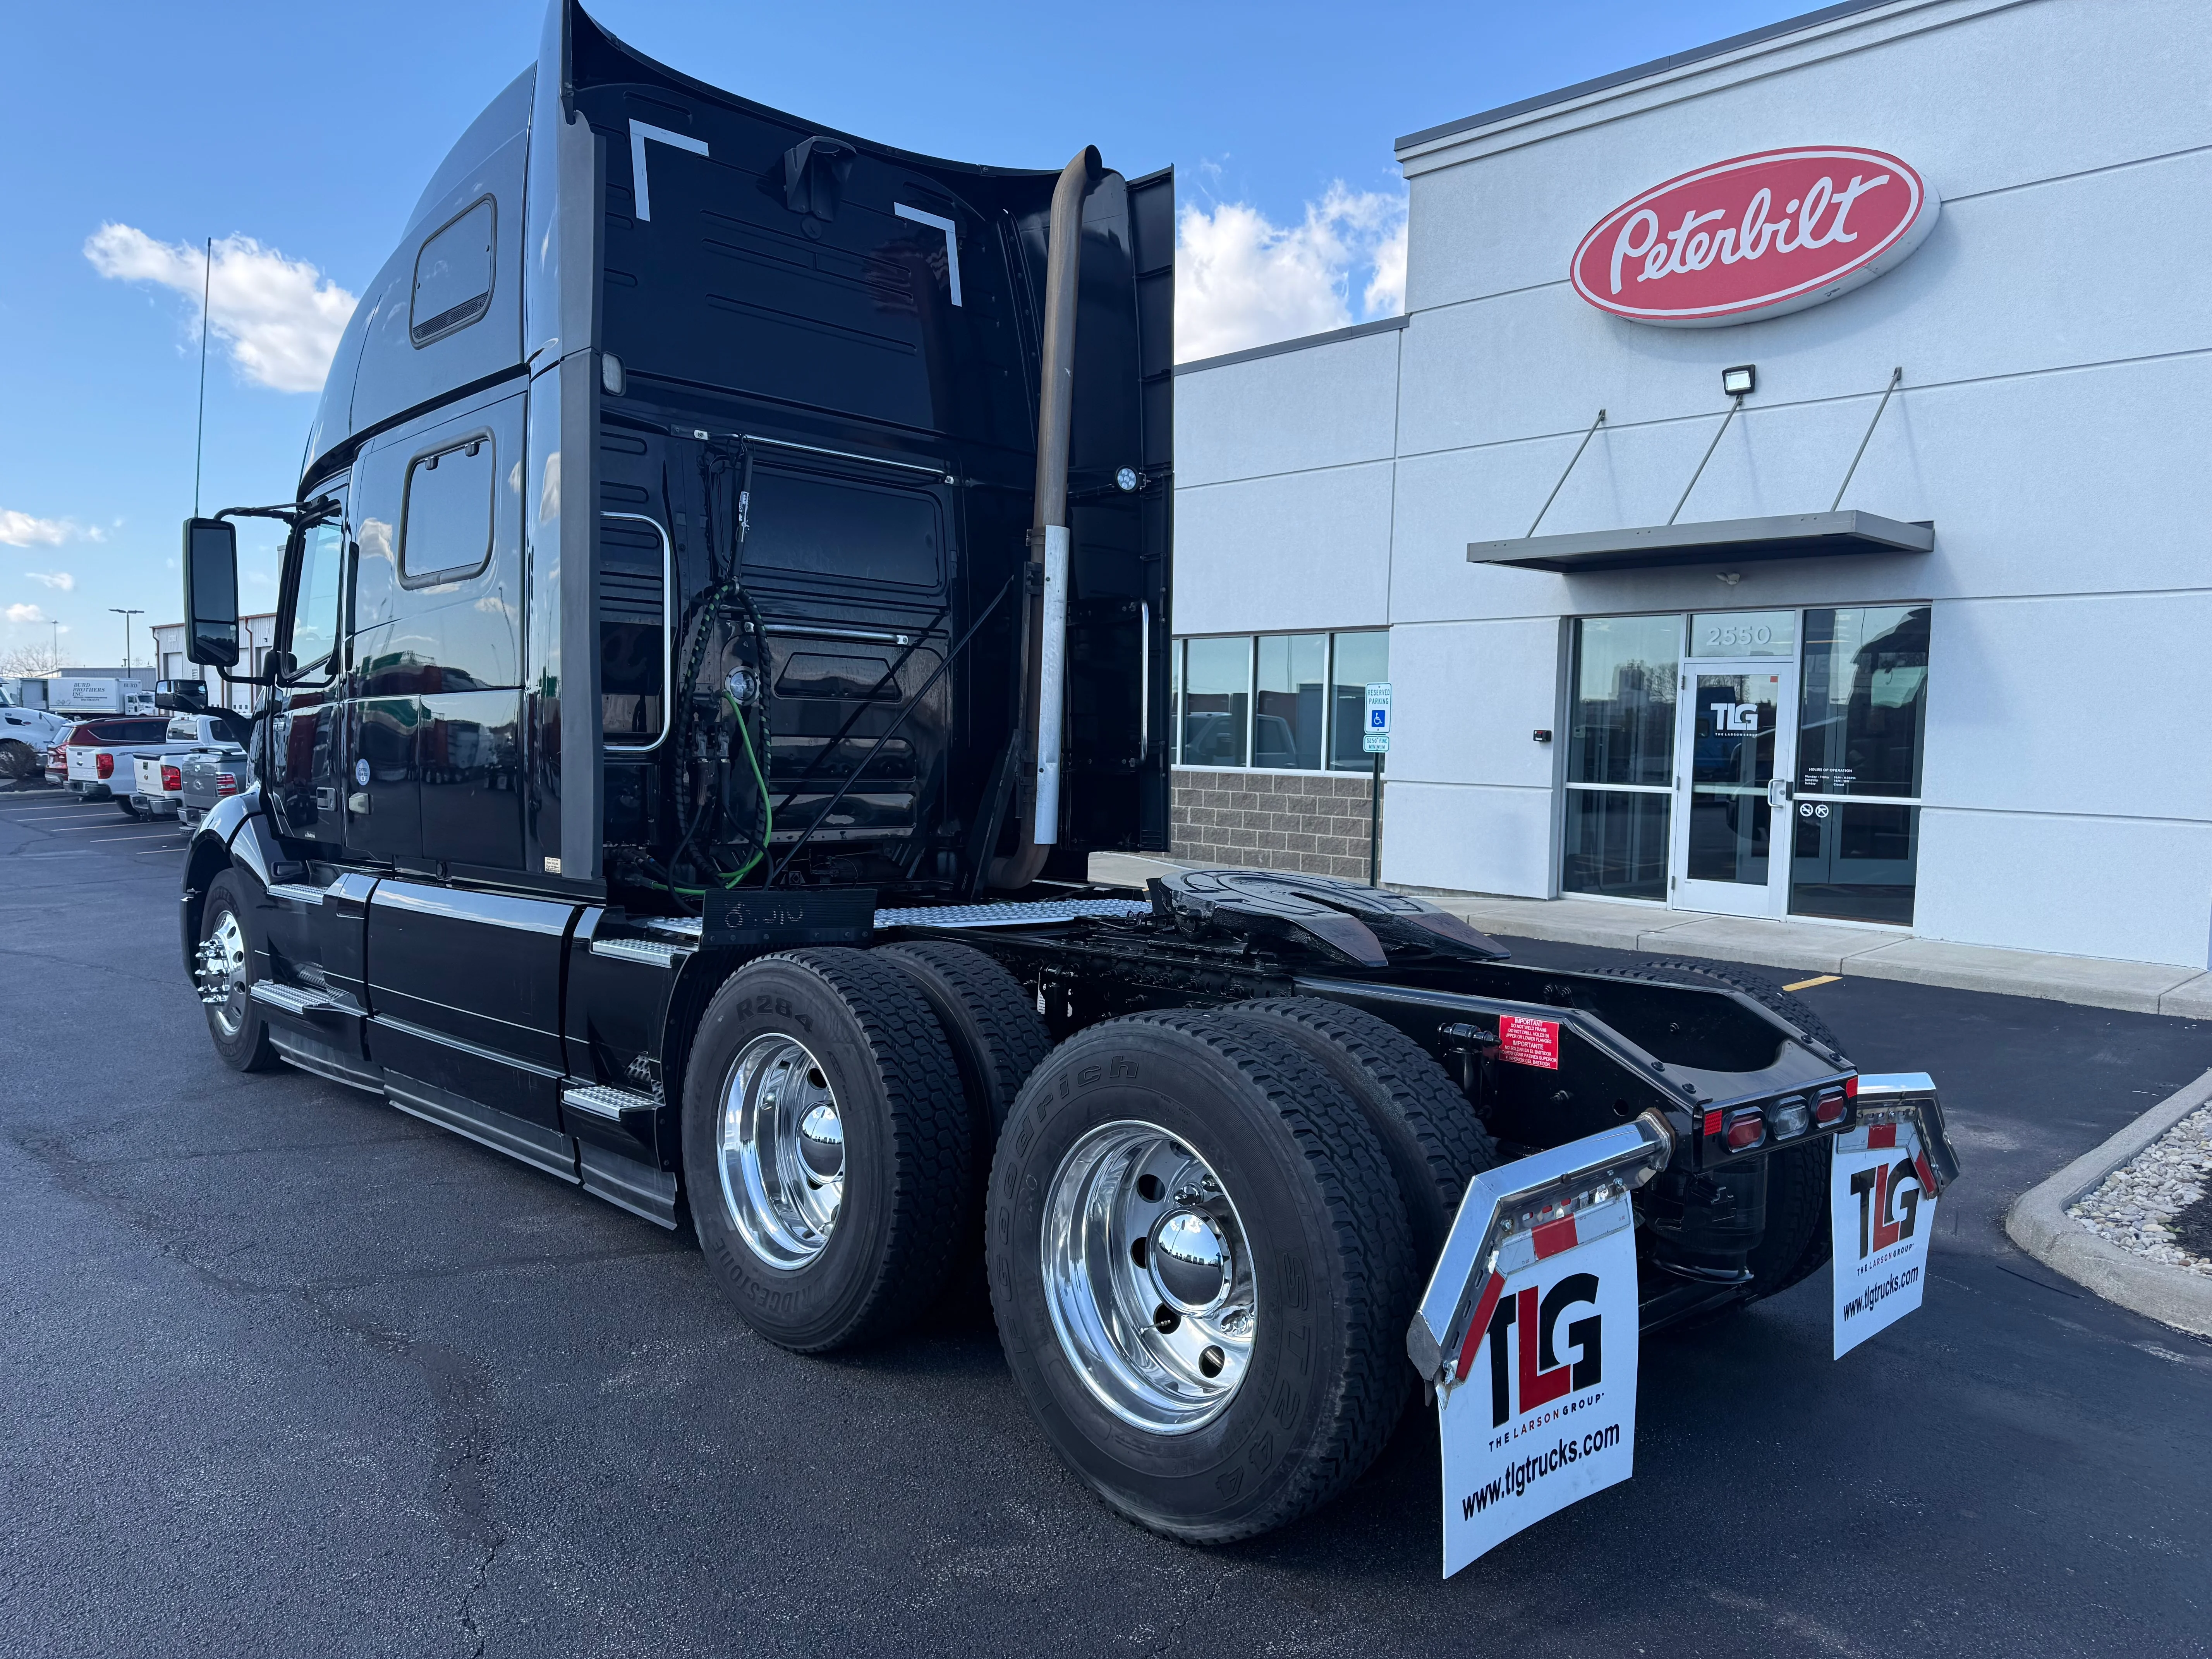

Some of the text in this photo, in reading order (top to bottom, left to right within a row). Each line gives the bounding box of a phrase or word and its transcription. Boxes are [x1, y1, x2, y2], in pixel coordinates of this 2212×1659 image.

[1610, 174, 1890, 294] Peterbilt
[1706, 625, 1771, 646] 2550
[1710, 703, 1758, 730] TLG
[736, 995, 814, 1034] R284
[1515, 1018, 1543, 1027] IMPORTANT
[1513, 1040, 1544, 1050] IMPORTANTE
[1850, 1158, 1920, 1261] TLG
[711, 1237, 826, 1314] BRIDGESTONE
[1857, 1243, 1913, 1276] THE LARSON GROUP
[1843, 1266, 1919, 1322] www.tlgtrucks.com
[1486, 1273, 1602, 1428] TLG
[1489, 1394, 1601, 1452] THE LARSON GROUP
[1462, 1423, 1620, 1522] www.tlgtrucks.com
